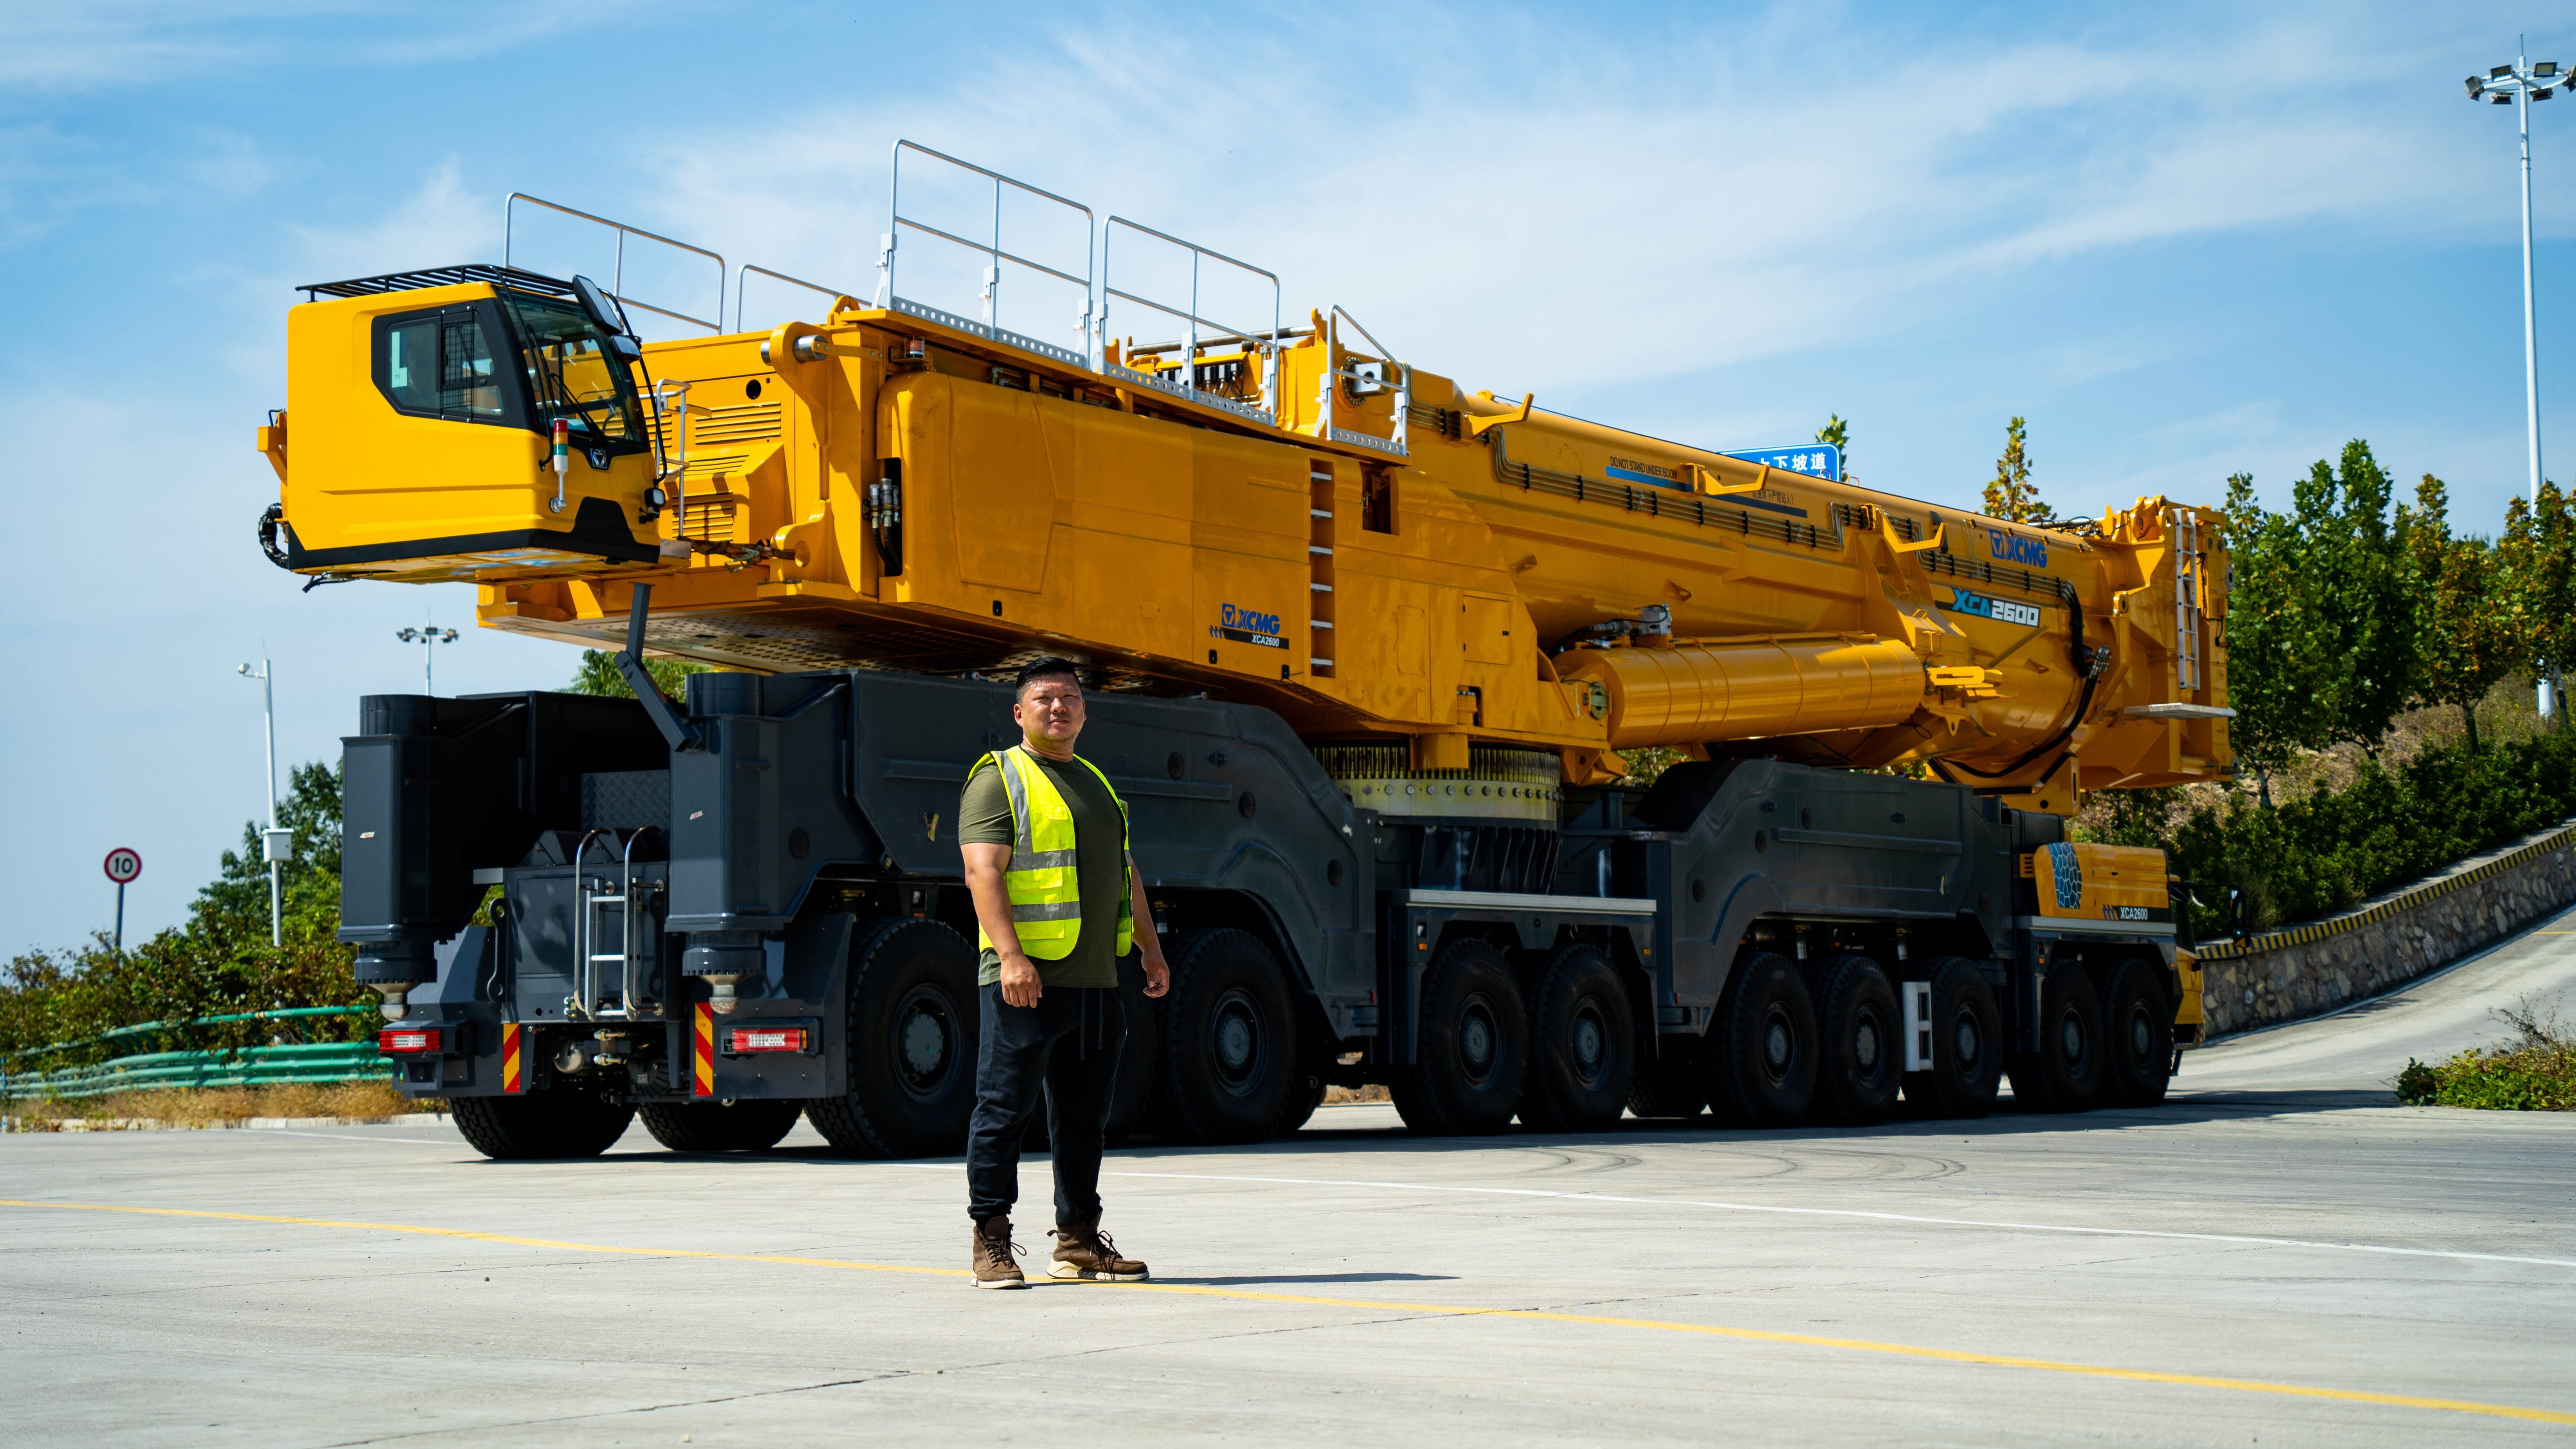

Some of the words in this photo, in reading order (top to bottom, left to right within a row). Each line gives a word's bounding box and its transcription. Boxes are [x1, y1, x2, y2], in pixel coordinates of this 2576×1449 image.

[1610, 456, 1618, 467] DO
[1619, 458, 1628, 469] NOT
[1629, 460, 1645, 472] STAND
[1646, 464, 1662, 476] UNDER
[2005, 535, 2047, 568] XCMG
[1952, 588, 2039, 626] XCA2600
[1235, 608, 1280, 635] XCMG
[1252, 634, 1279, 647] XCA2600
[115, 857, 133, 874] 10
[2120, 907, 2148, 920] XCA2600
